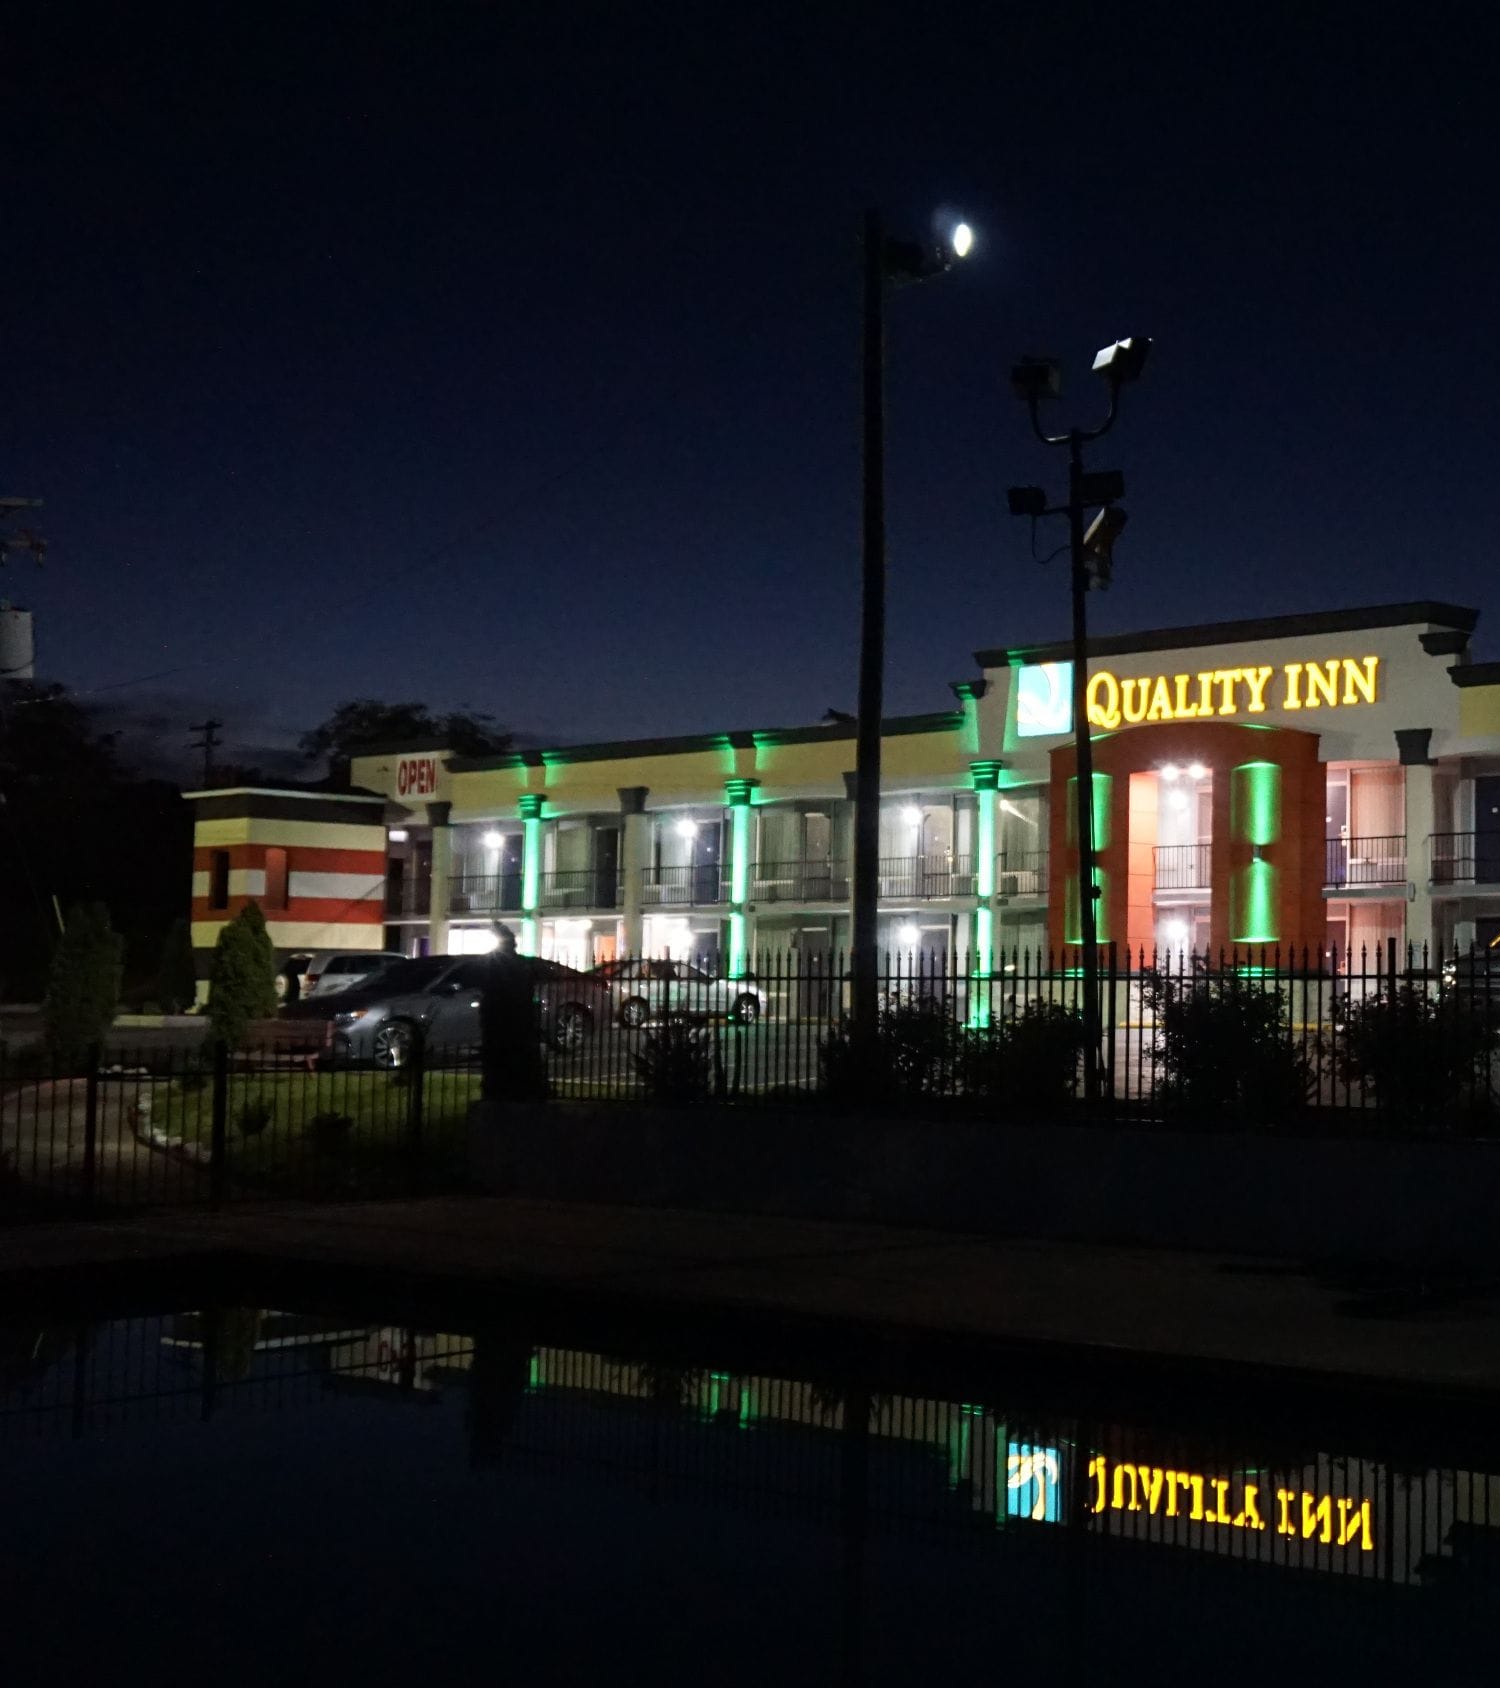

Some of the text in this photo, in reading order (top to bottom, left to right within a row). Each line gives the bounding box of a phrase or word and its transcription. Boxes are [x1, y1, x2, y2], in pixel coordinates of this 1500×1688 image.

[1086, 655, 1379, 730] QUALITY INN
[398, 758, 436, 795] OPEN
